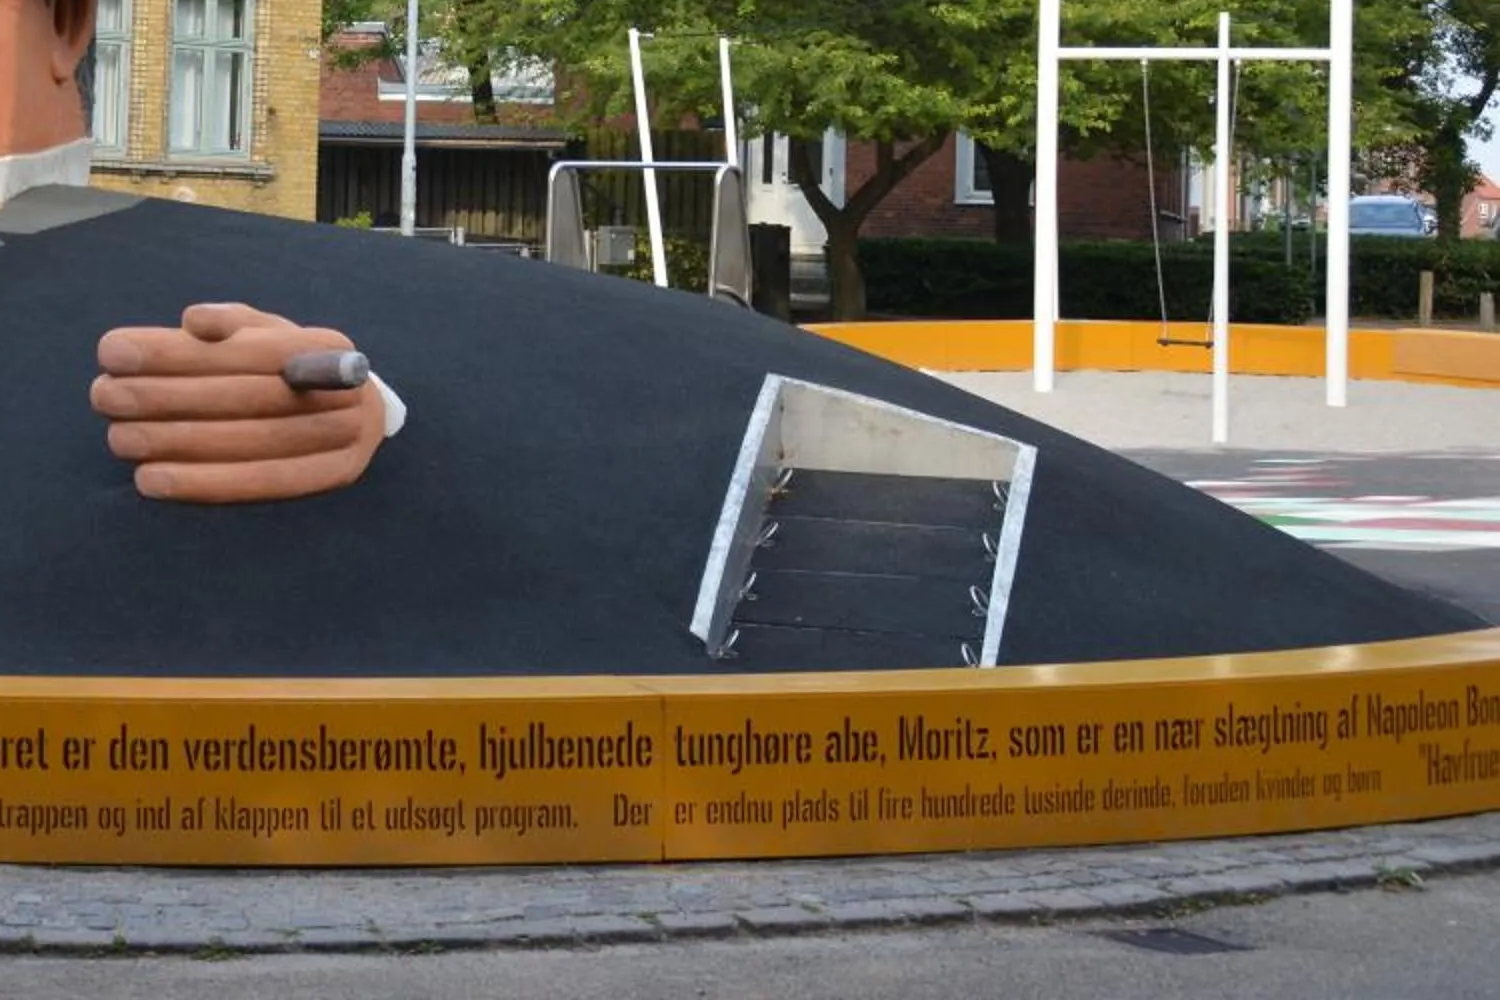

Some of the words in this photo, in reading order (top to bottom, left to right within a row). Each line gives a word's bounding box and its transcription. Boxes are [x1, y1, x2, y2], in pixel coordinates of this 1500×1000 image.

[63, 736, 96, 771] er
[109, 723, 169, 771] den
[183, 723, 466, 775] verdensberømte,
[480, 721, 653, 780] hjulbenede
[674, 718, 812, 775] tunghøre
[825, 716, 886, 767] abe,
[899, 714, 997, 761] Moritz,
[1008, 723, 1066, 758] som
[1077, 722, 1103, 755] er
[1114, 719, 1144, 752] en
[1155, 717, 1204, 750] nær
[1214, 702, 1328, 755] slægtning
[1337, 693, 1359, 740] af
[1367, 688, 1460, 744] Napoleon
[98, 804, 126, 838] og
[135, 796, 170, 831] ind
[180, 797, 206, 831] af
[215, 796, 309, 838] klappen
[320, 797, 341, 832] til
[351, 800, 377, 832] et
[385, 797, 466, 837] udsøgt
[474, 803, 578, 837] program.
[613, 792, 653, 827] Der
[674, 800, 697, 825] er
[706, 790, 773, 825] endnu
[782, 788, 840, 830] plads
[850, 788, 869, 822] til
[878, 787, 915, 820] fire
[921, 782, 1015, 820] hundrede
[1024, 778, 1094, 816] tusinde
[1182, 771, 1249, 808] foruden
[1256, 766, 1315, 801] kvinder
[1323, 770, 1341, 802] og
